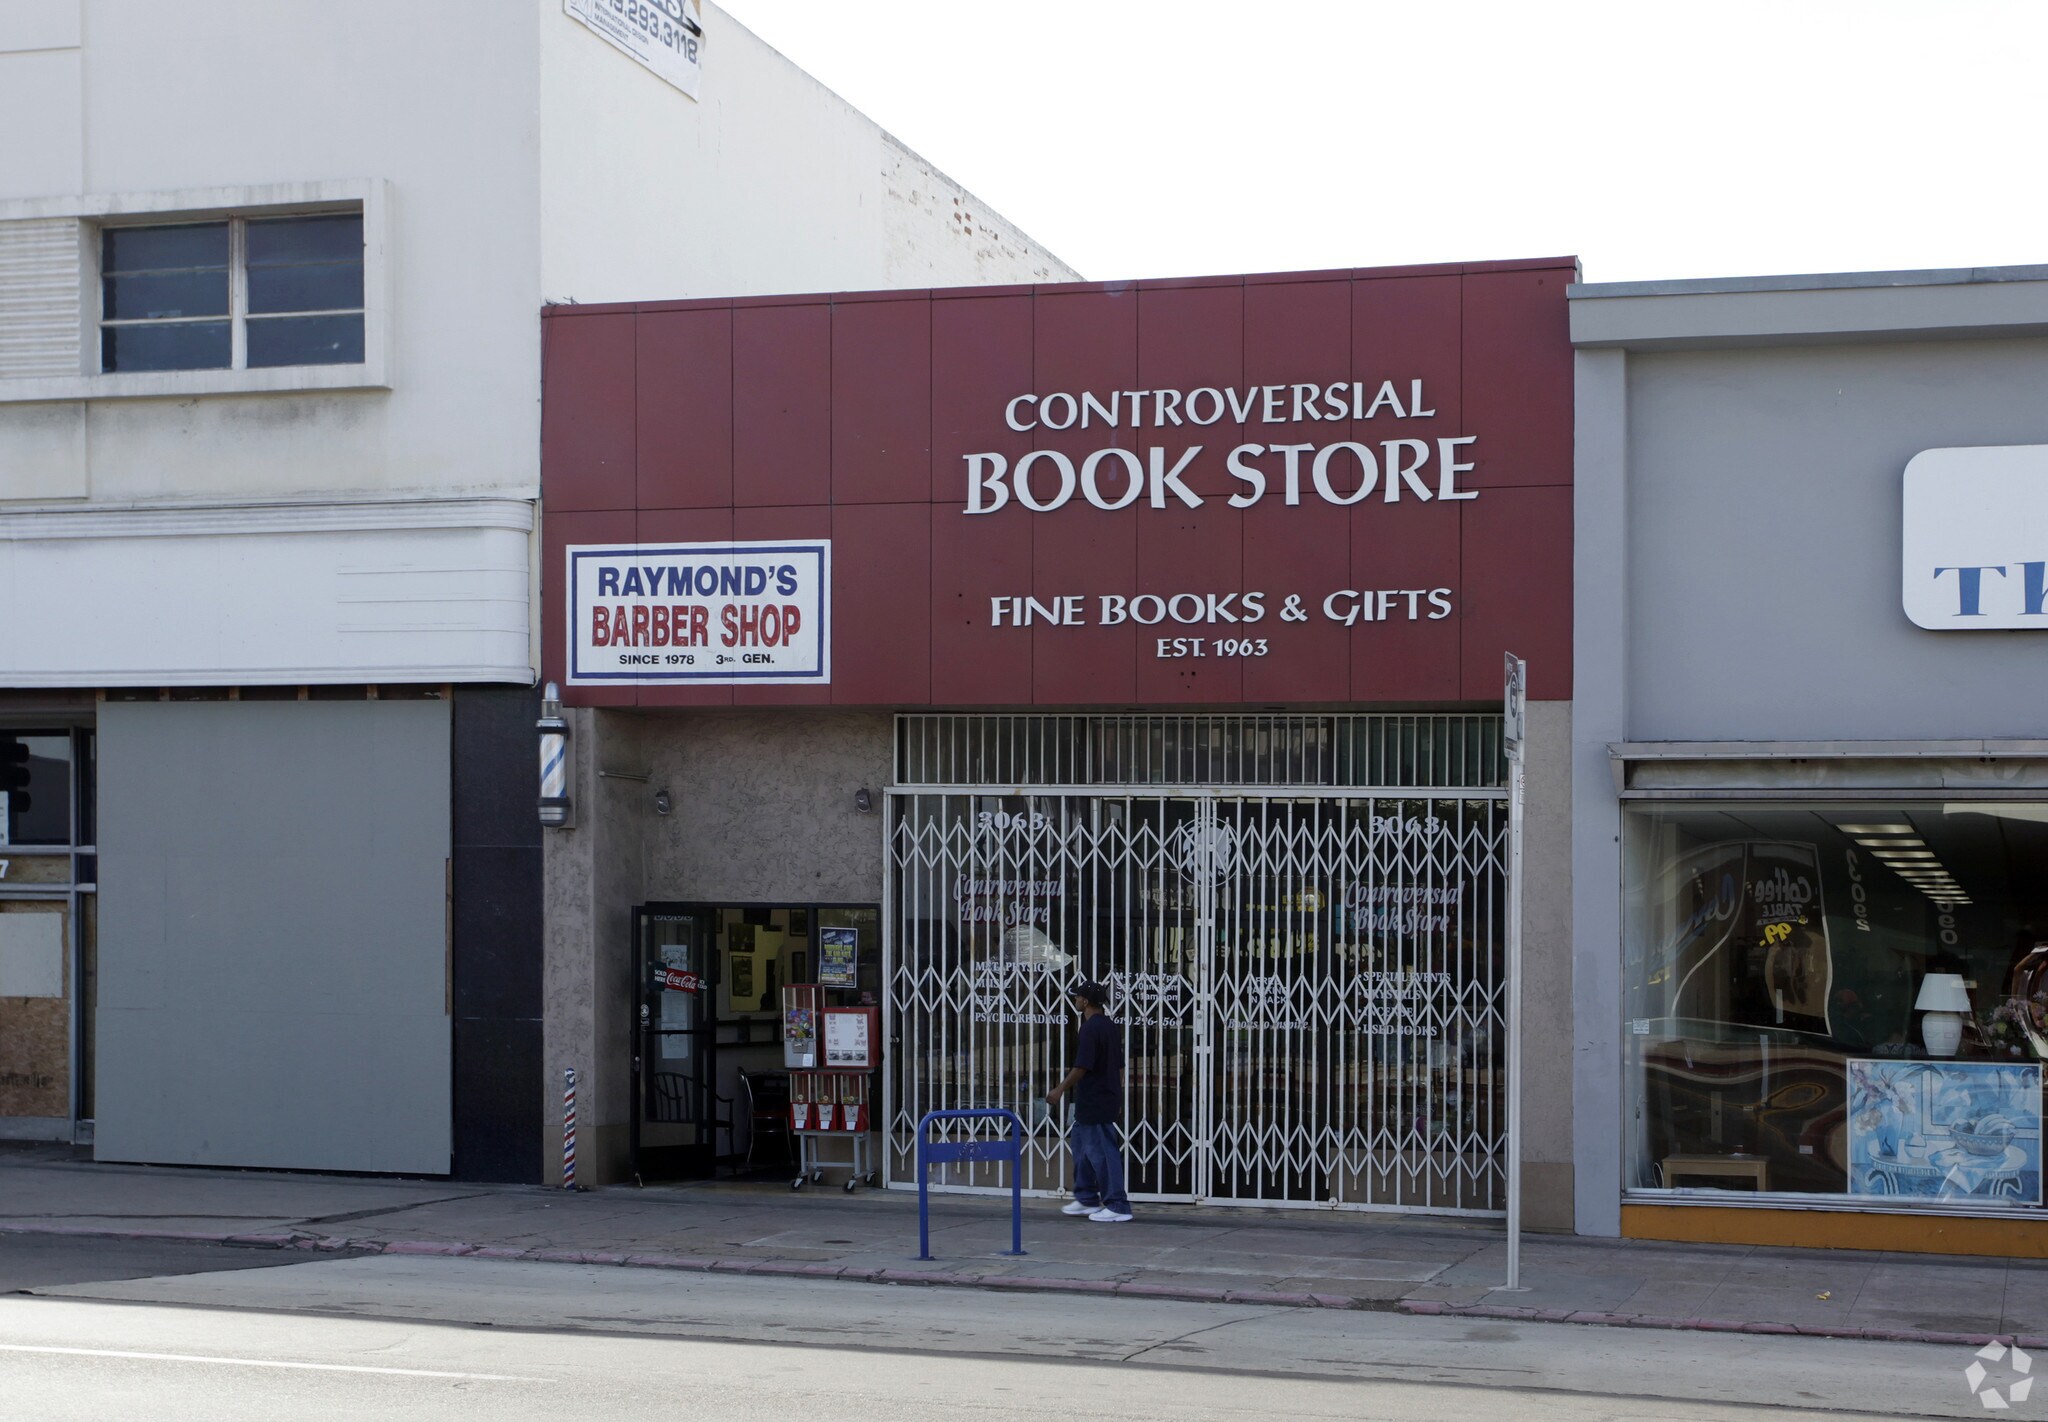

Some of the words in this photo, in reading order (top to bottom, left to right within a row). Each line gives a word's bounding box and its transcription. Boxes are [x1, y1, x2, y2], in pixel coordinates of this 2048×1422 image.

[1005, 379, 1436, 432] CONTROVERSIAL
[963, 446, 1205, 515] BOOK
[1226, 435, 1480, 508] STORE
[598, 565, 798, 597] RAYMOND'S
[990, 595, 1086, 627] FINE
[1099, 591, 1266, 626] BOOKS
[1279, 593, 1309, 623] &
[1322, 587, 1453, 627] GIFTS
[592, 605, 709, 647] BARBER
[720, 603, 801, 648] SHOP
[619, 654, 660, 665] SINCE
[665, 654, 695, 665] 1978
[742, 653, 775, 665] GEN.
[1156, 637, 1206, 658] EST.
[1212, 638, 1269, 658] 1963
[977, 811, 1045, 830] 3063
[1370, 815, 1441, 834] 3063
[953, 873, 1067, 901] Controversia
[1345, 880, 1466, 909] Controversial
[961, 900, 1004, 922] Book
[1005, 900, 1051, 926] Store
[1354, 906, 1402, 930] Book
[1402, 907, 1451, 935] Store
[975, 961, 1050, 973] MTPHYSIC
[975, 978, 1012, 989] MUSC
[1247, 986, 1289, 995] PAKIN
[1363, 989, 1422, 1000] CRYSALS
[1018, 1013, 1069, 1025] READNGS
